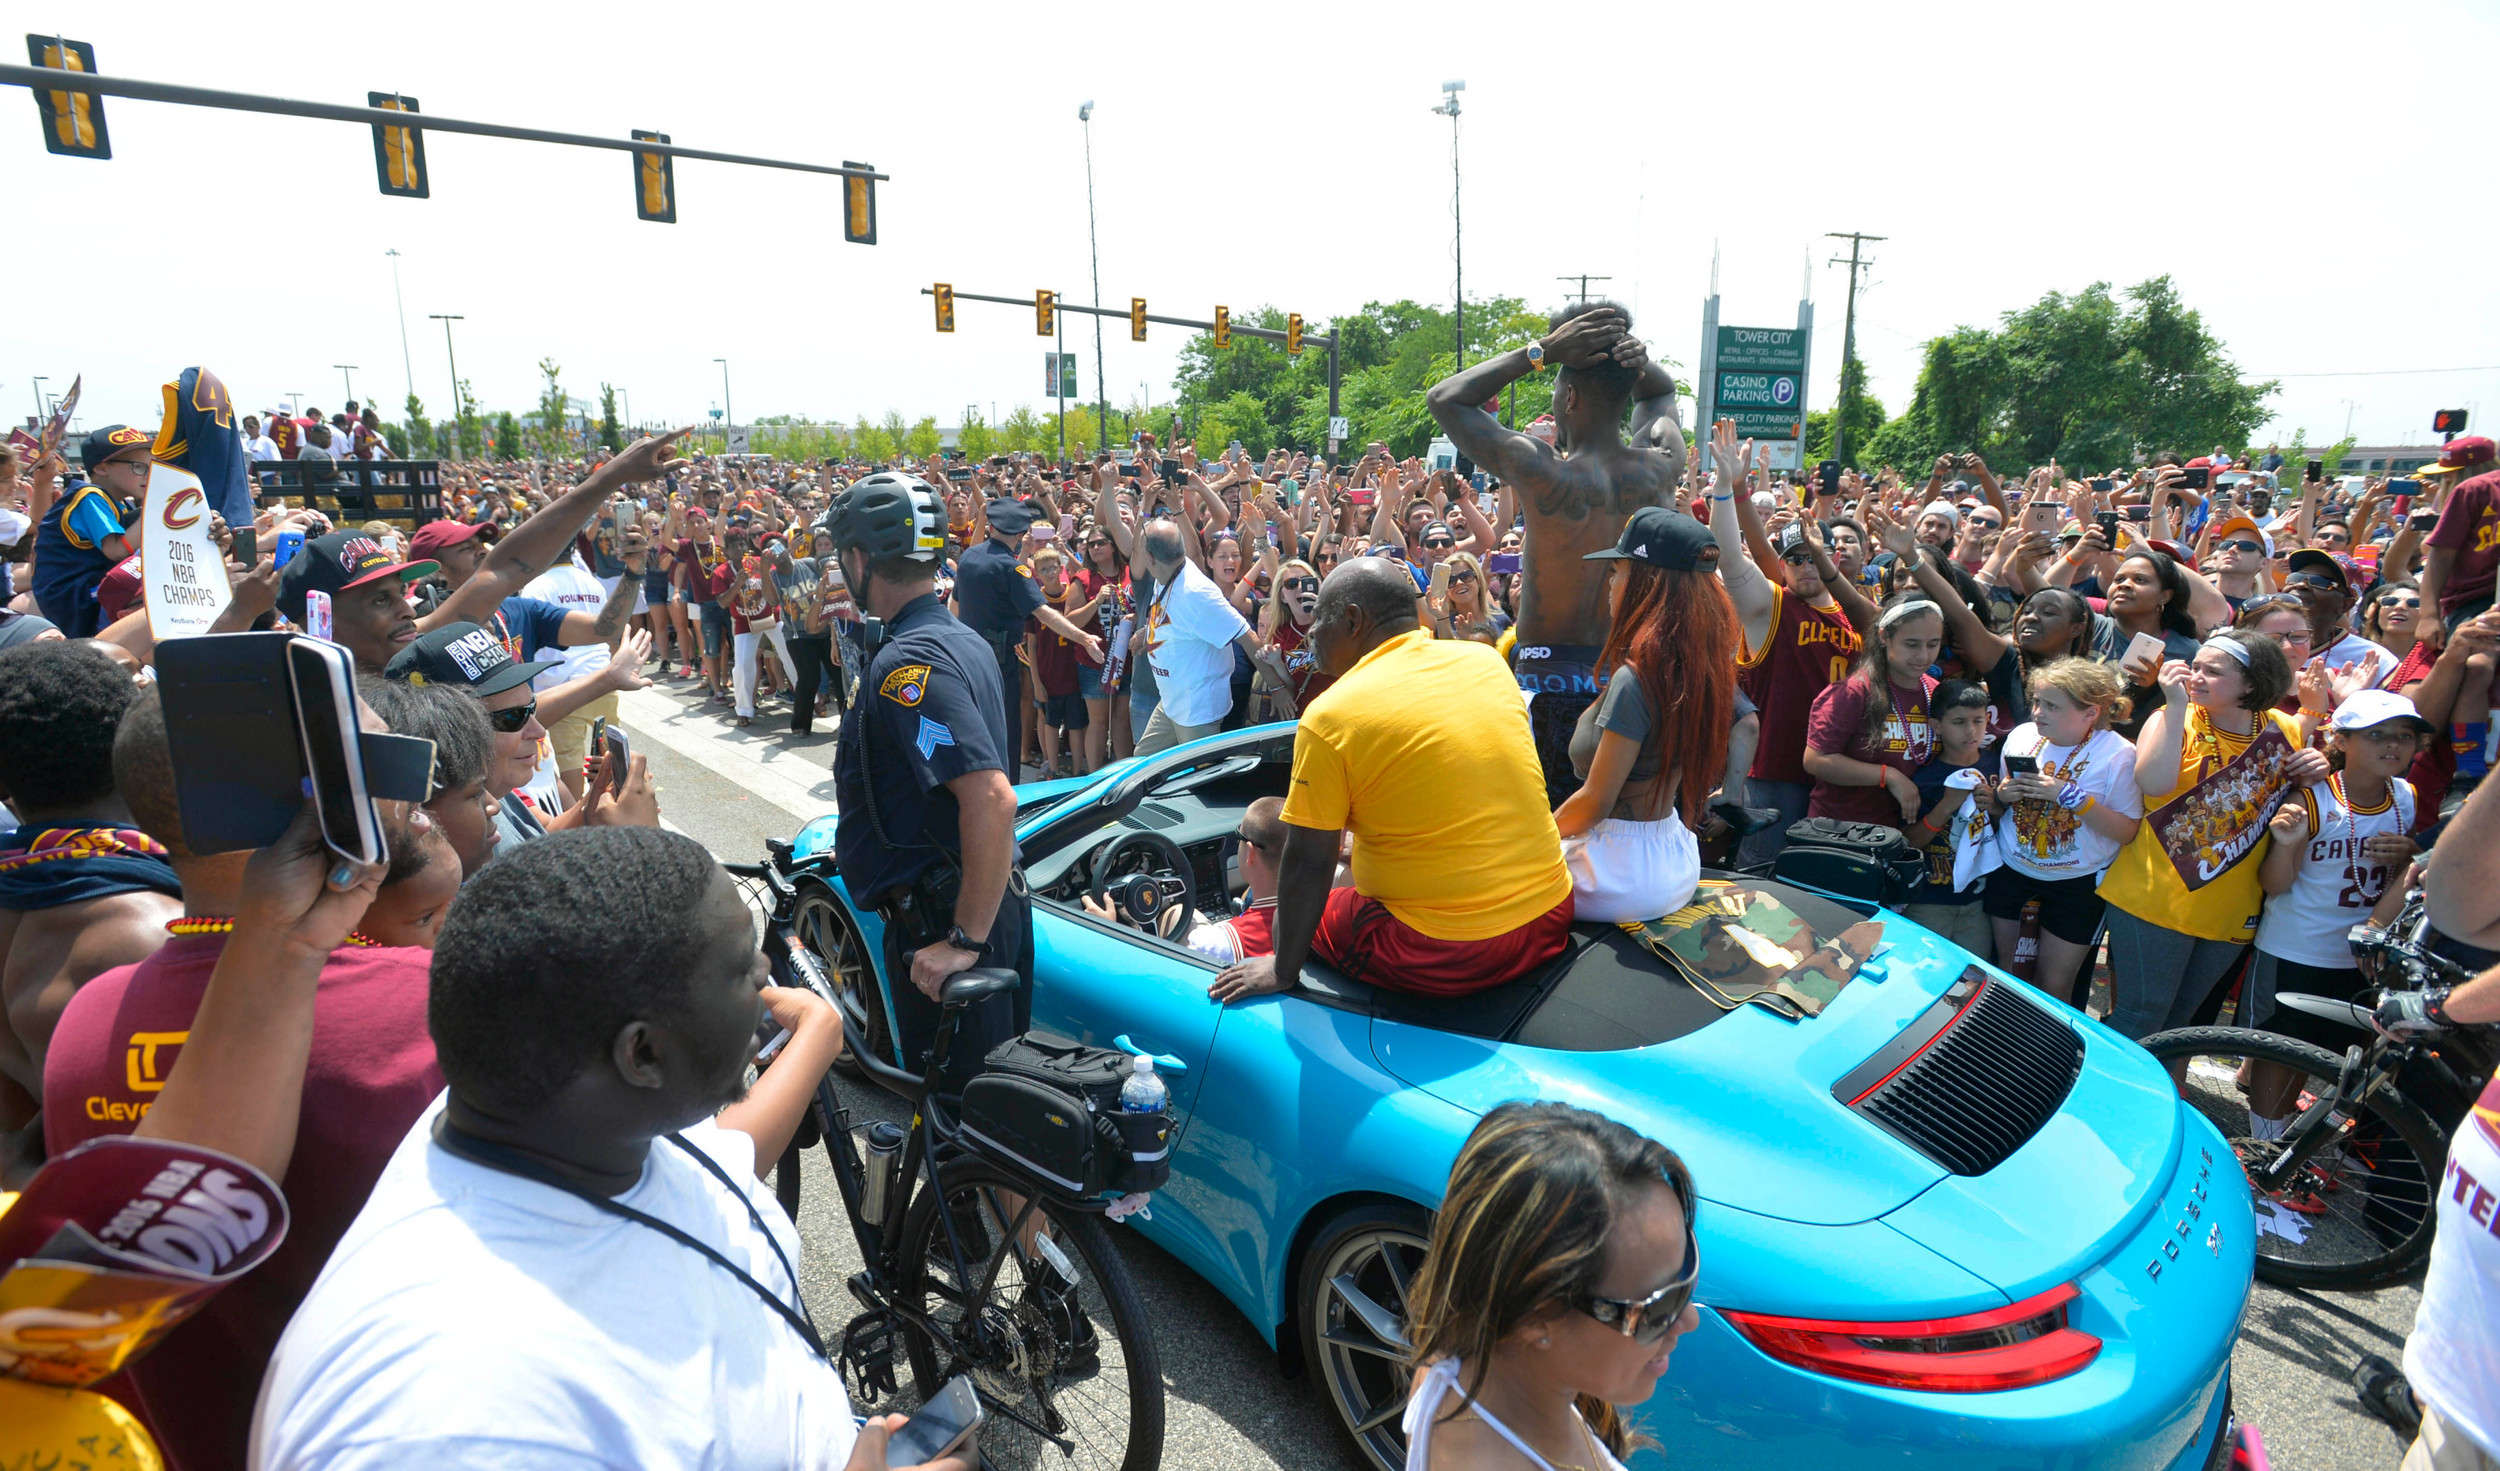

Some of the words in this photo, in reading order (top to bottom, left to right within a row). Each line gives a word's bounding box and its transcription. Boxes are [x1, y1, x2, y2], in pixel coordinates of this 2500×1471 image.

[1734, 330, 1769, 344] TOWER
[1771, 332, 1792, 344] CITY
[1719, 355, 1756, 364] RESTAURANTS
[1759, 357, 1803, 366] ENTERTAINMENT
[1725, 347, 1741, 355] RETAIL
[1746, 347, 1769, 356] OFFICES
[1774, 349, 1798, 357] CINEMAS
[1724, 375, 1768, 389] CASINO
[1778, 381, 1791, 400] P
[1723, 389, 1771, 402] PARKING
[1746, 413, 1764, 423] CITY
[1766, 415, 1800, 424] PARKING
[278, 433, 288, 449] 5
[169, 540, 194, 562] 2016
[172, 563, 197, 584] NBA
[163, 584, 216, 607] CHAMPS
[884, 667, 925, 692] CLEVELAND
[890, 673, 919, 691] POLICE
[2038, 859, 2081, 868] CHAMPIONS
[2338, 865, 2387, 908] 23
[141, 1159, 206, 1199] NBA
[2146, 1147, 2213, 1285] PORSCHE
